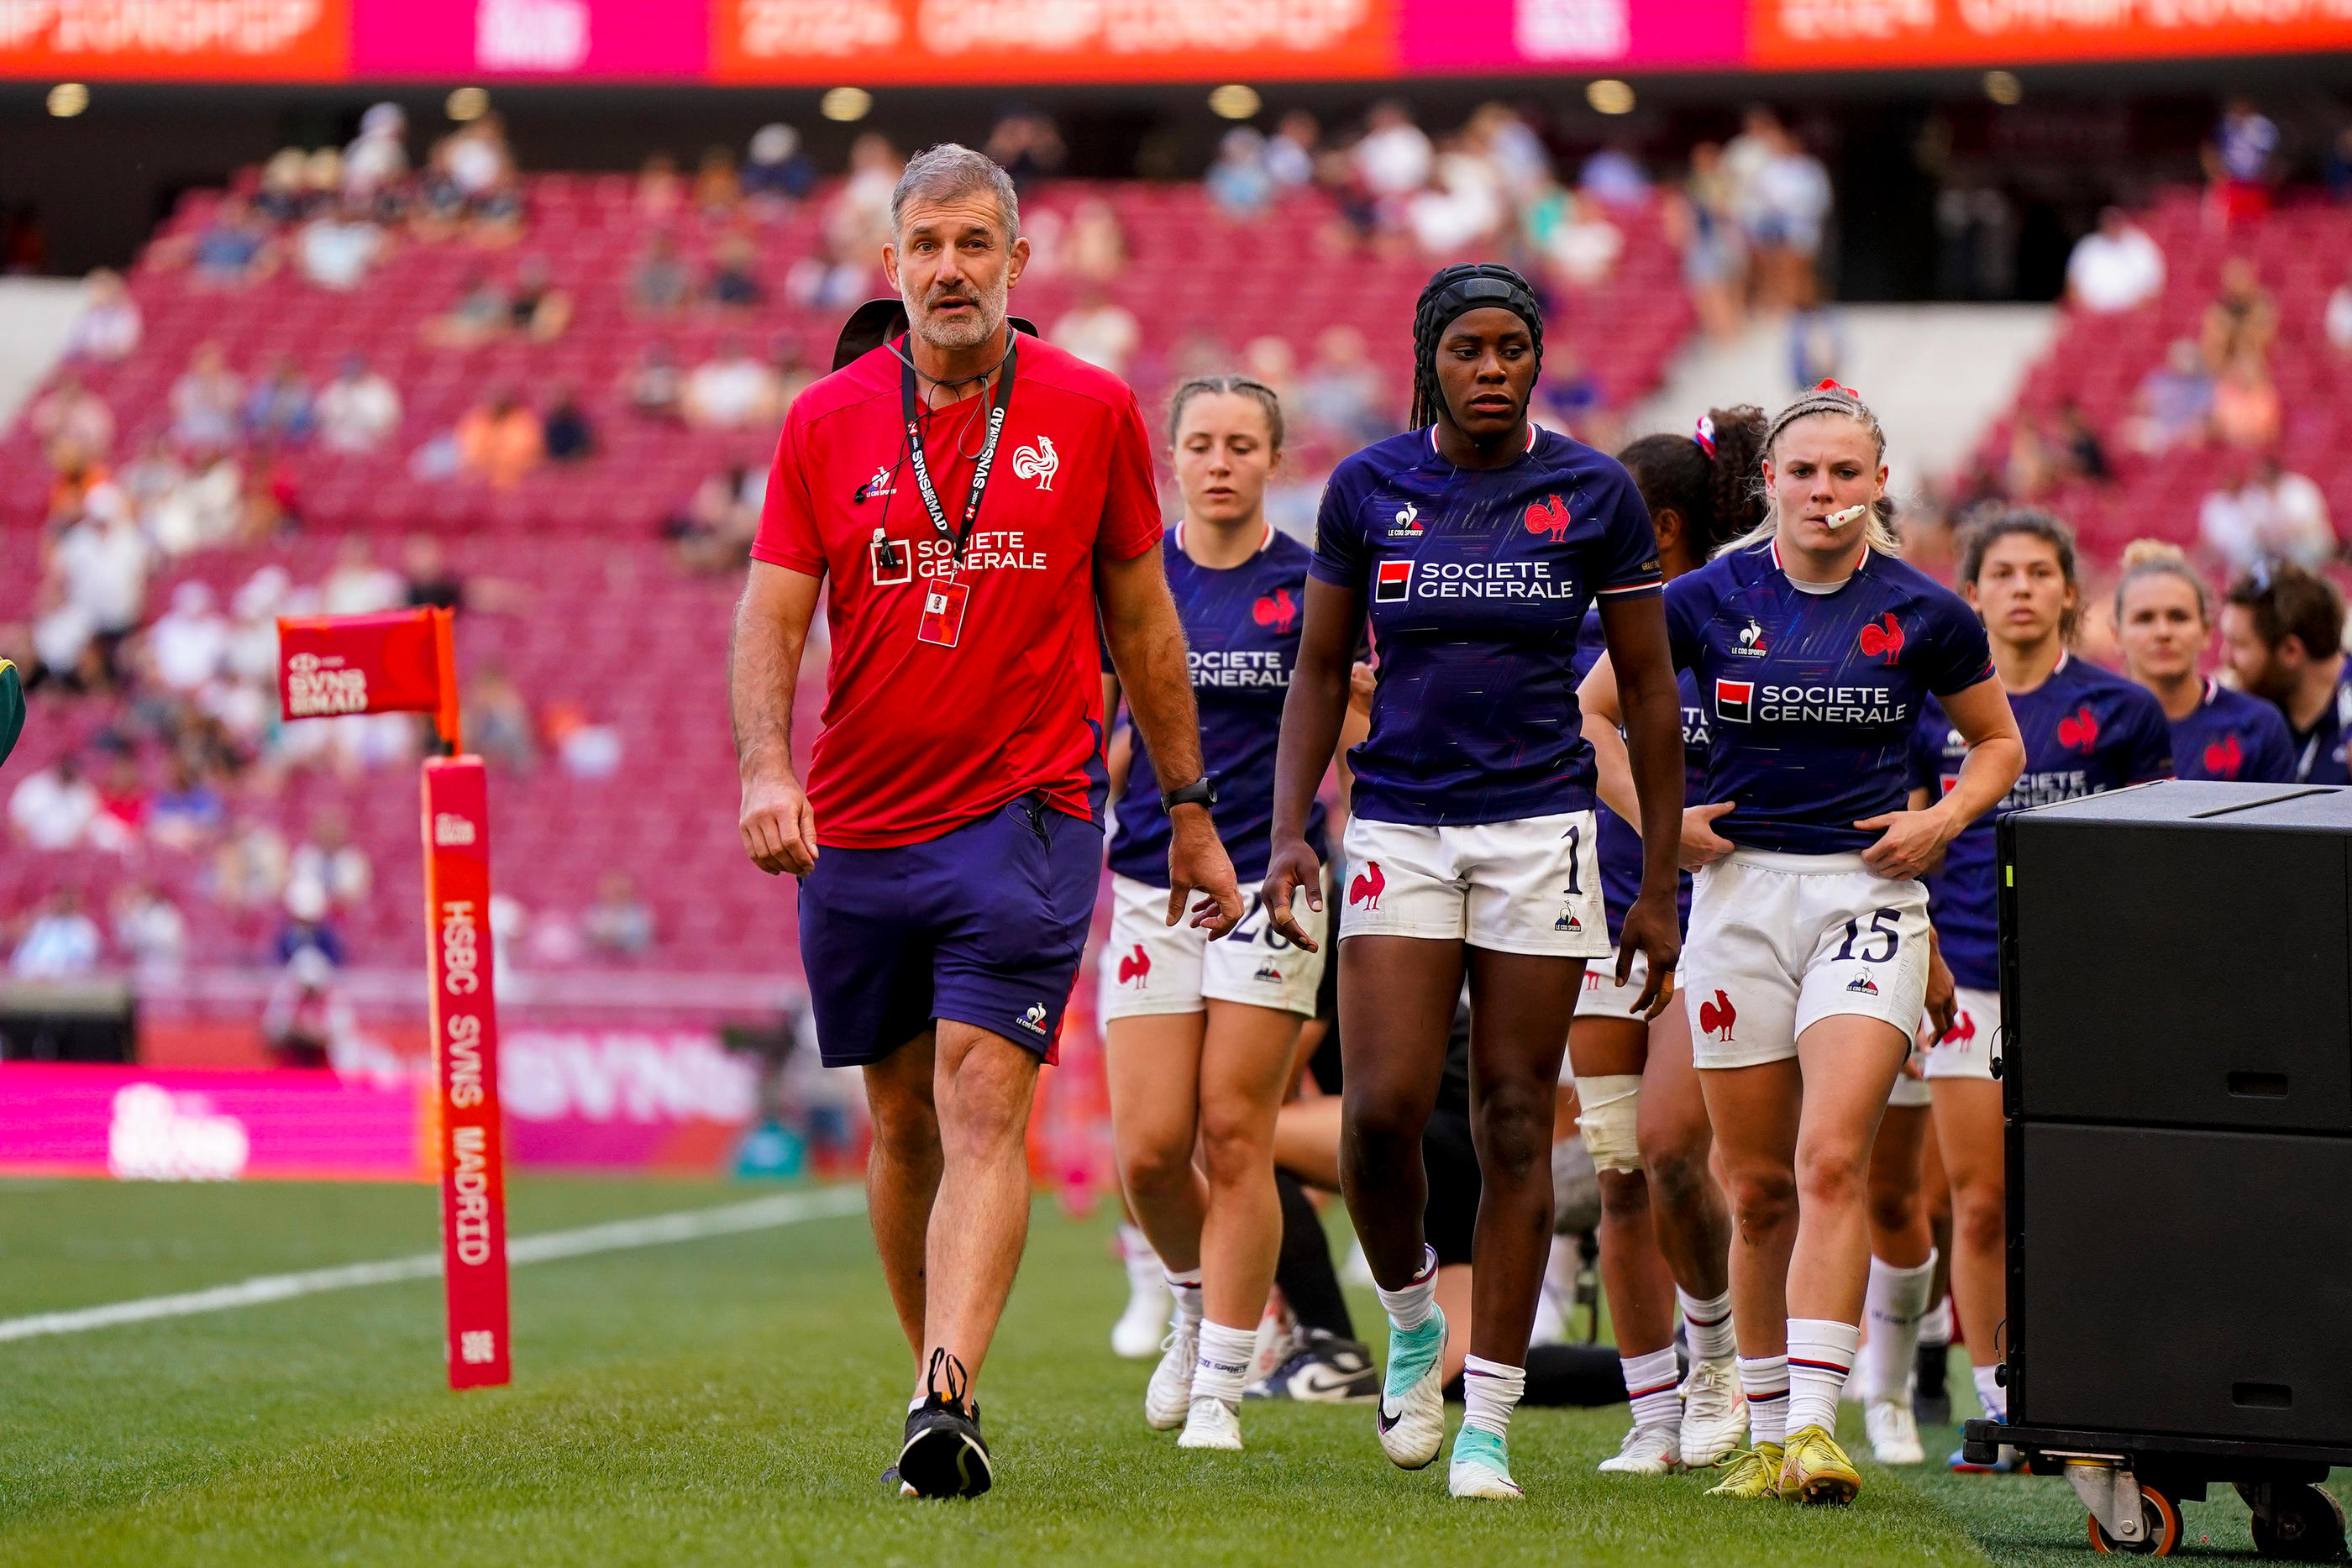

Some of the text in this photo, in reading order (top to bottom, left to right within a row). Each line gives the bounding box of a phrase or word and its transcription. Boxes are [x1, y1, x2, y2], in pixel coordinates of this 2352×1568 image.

[973, 448, 995, 490] SVNS
[990, 406, 1005, 438] MAD
[912, 449, 932, 491] SVNS
[927, 499, 948, 531] MAD
[1417, 580, 1573, 599] GENERALE
[1420, 562, 1551, 579] SOCIETE
[1186, 651, 1282, 669] OCIETE
[1760, 703, 1907, 724] GENERALE
[1761, 686, 1889, 705] SOCIETE
[1561, 825, 1583, 895] 1
[1831, 908, 1902, 963] 15
[442, 899, 491, 1266] HSBC SVNS MADRID
